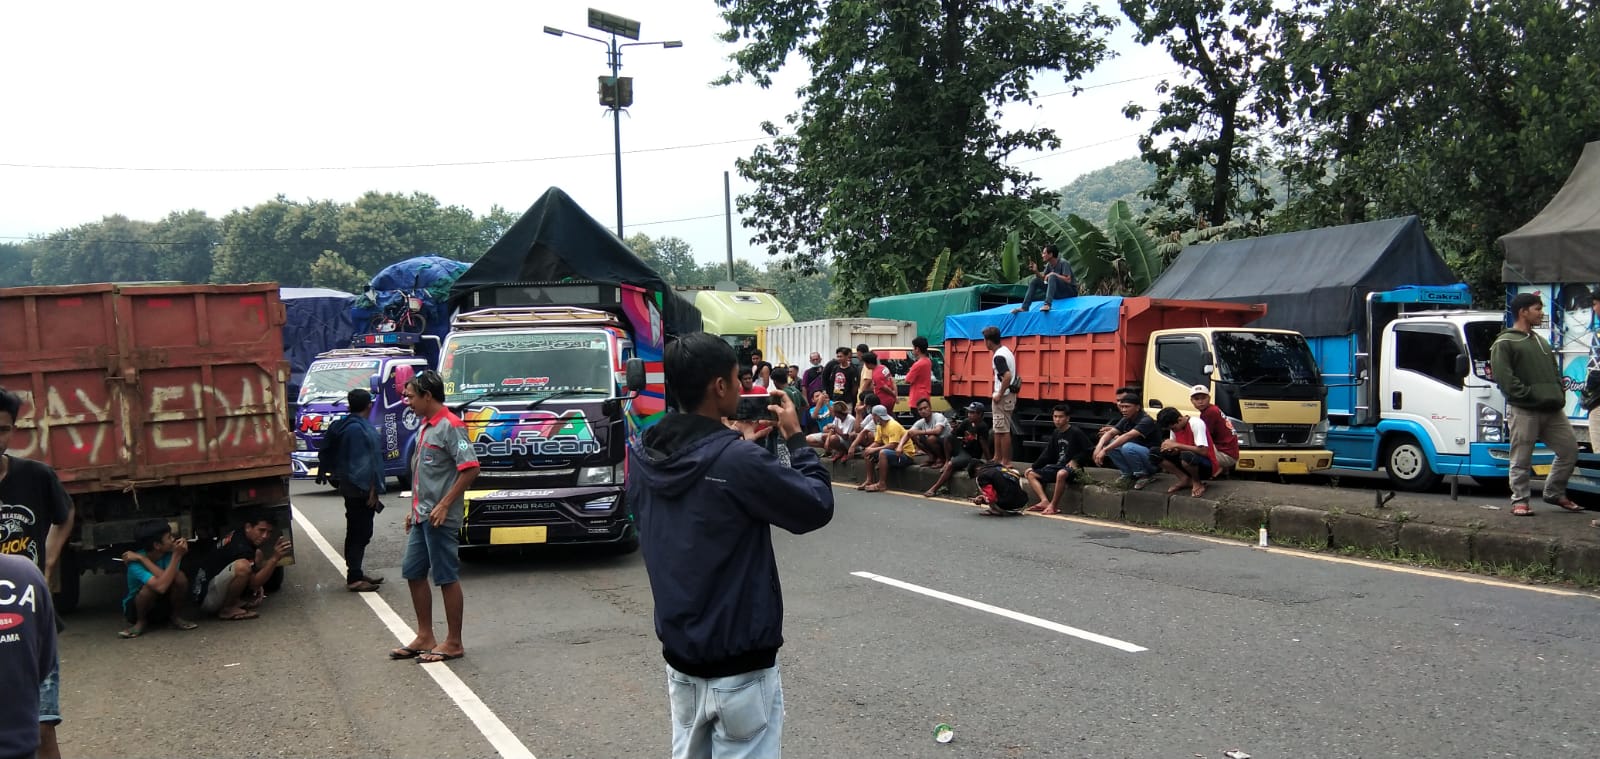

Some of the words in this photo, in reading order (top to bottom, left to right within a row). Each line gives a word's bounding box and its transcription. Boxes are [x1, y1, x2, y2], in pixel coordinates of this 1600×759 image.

[1428, 292, 1460, 300] Cakra
[473, 437, 527, 456] ack
[526, 436, 600, 455] Team
[486, 503, 528, 511] TENTANG
[0, 633, 20, 643] AMA
